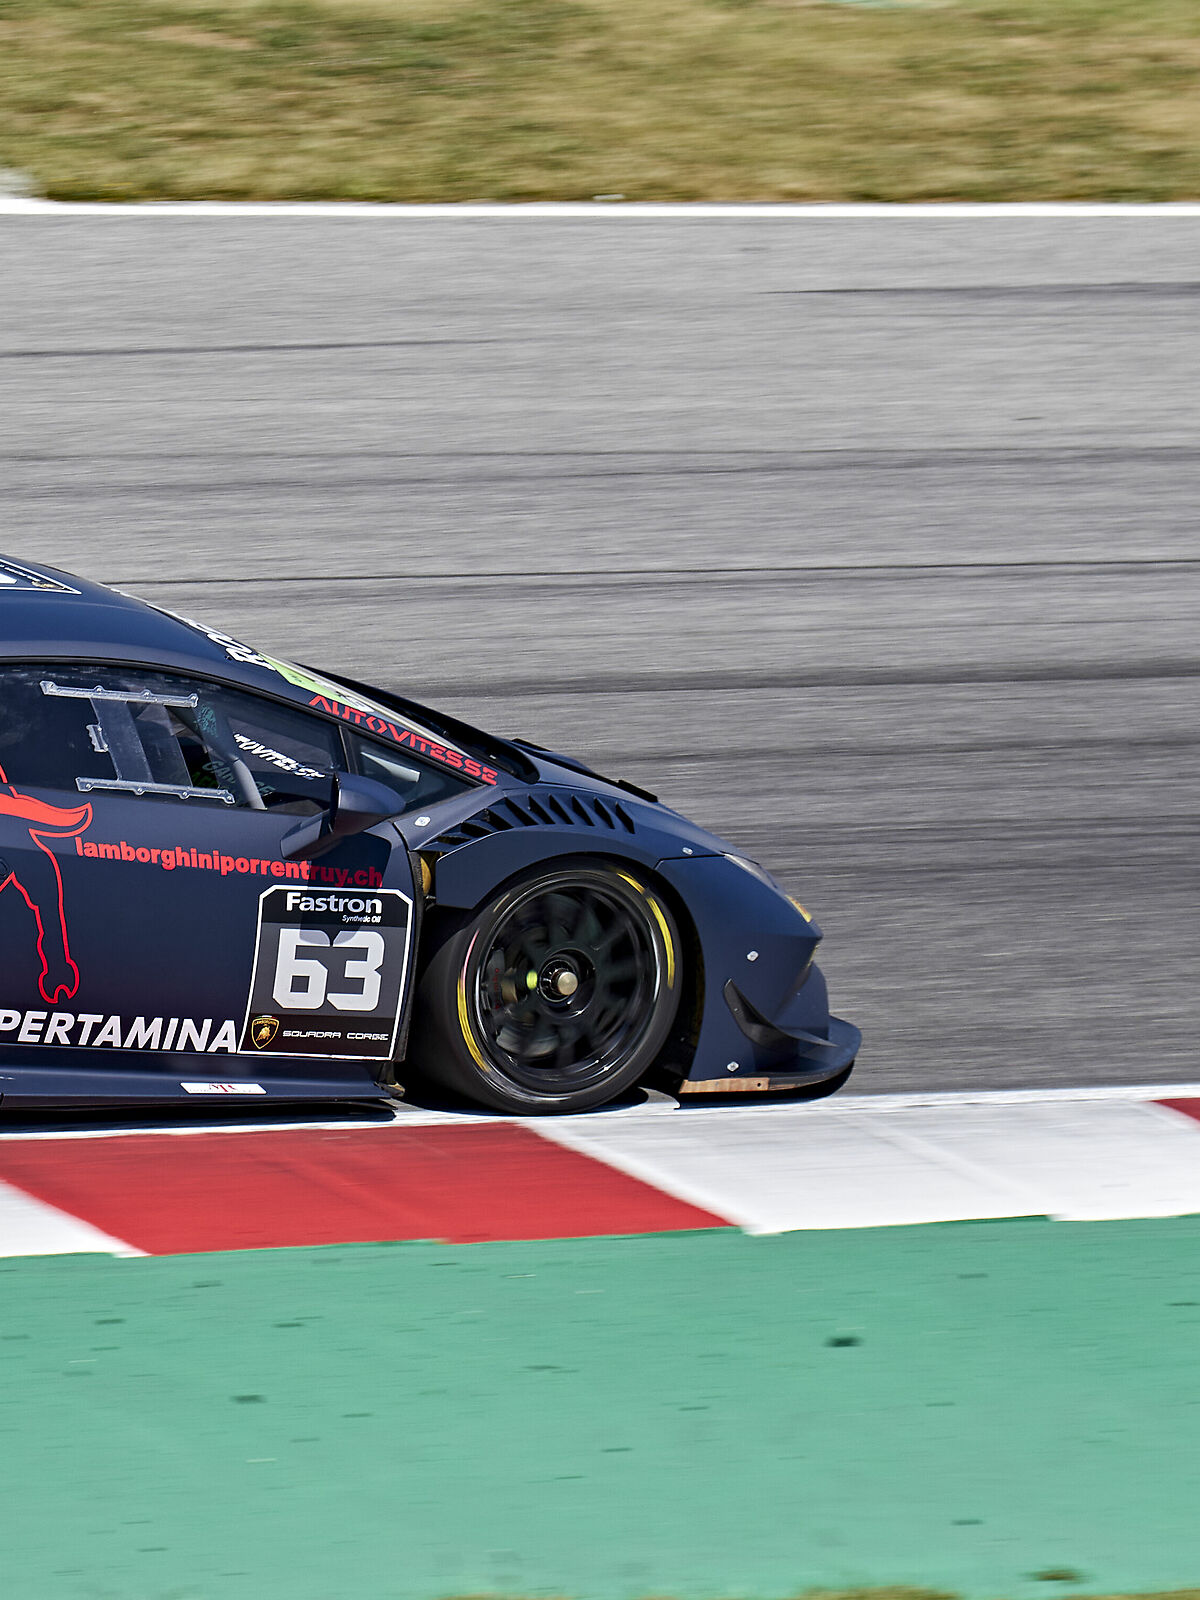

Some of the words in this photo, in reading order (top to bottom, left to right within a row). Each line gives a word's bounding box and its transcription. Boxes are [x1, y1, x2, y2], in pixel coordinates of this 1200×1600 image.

[308, 694, 499, 786] AUTOVITESSE
[74, 836, 384, 888] lamborghiniporrentruy.ch
[286, 891, 383, 914] Fastron
[272, 928, 385, 1012] 63
[282, 1030, 342, 1040] SQUADRA
